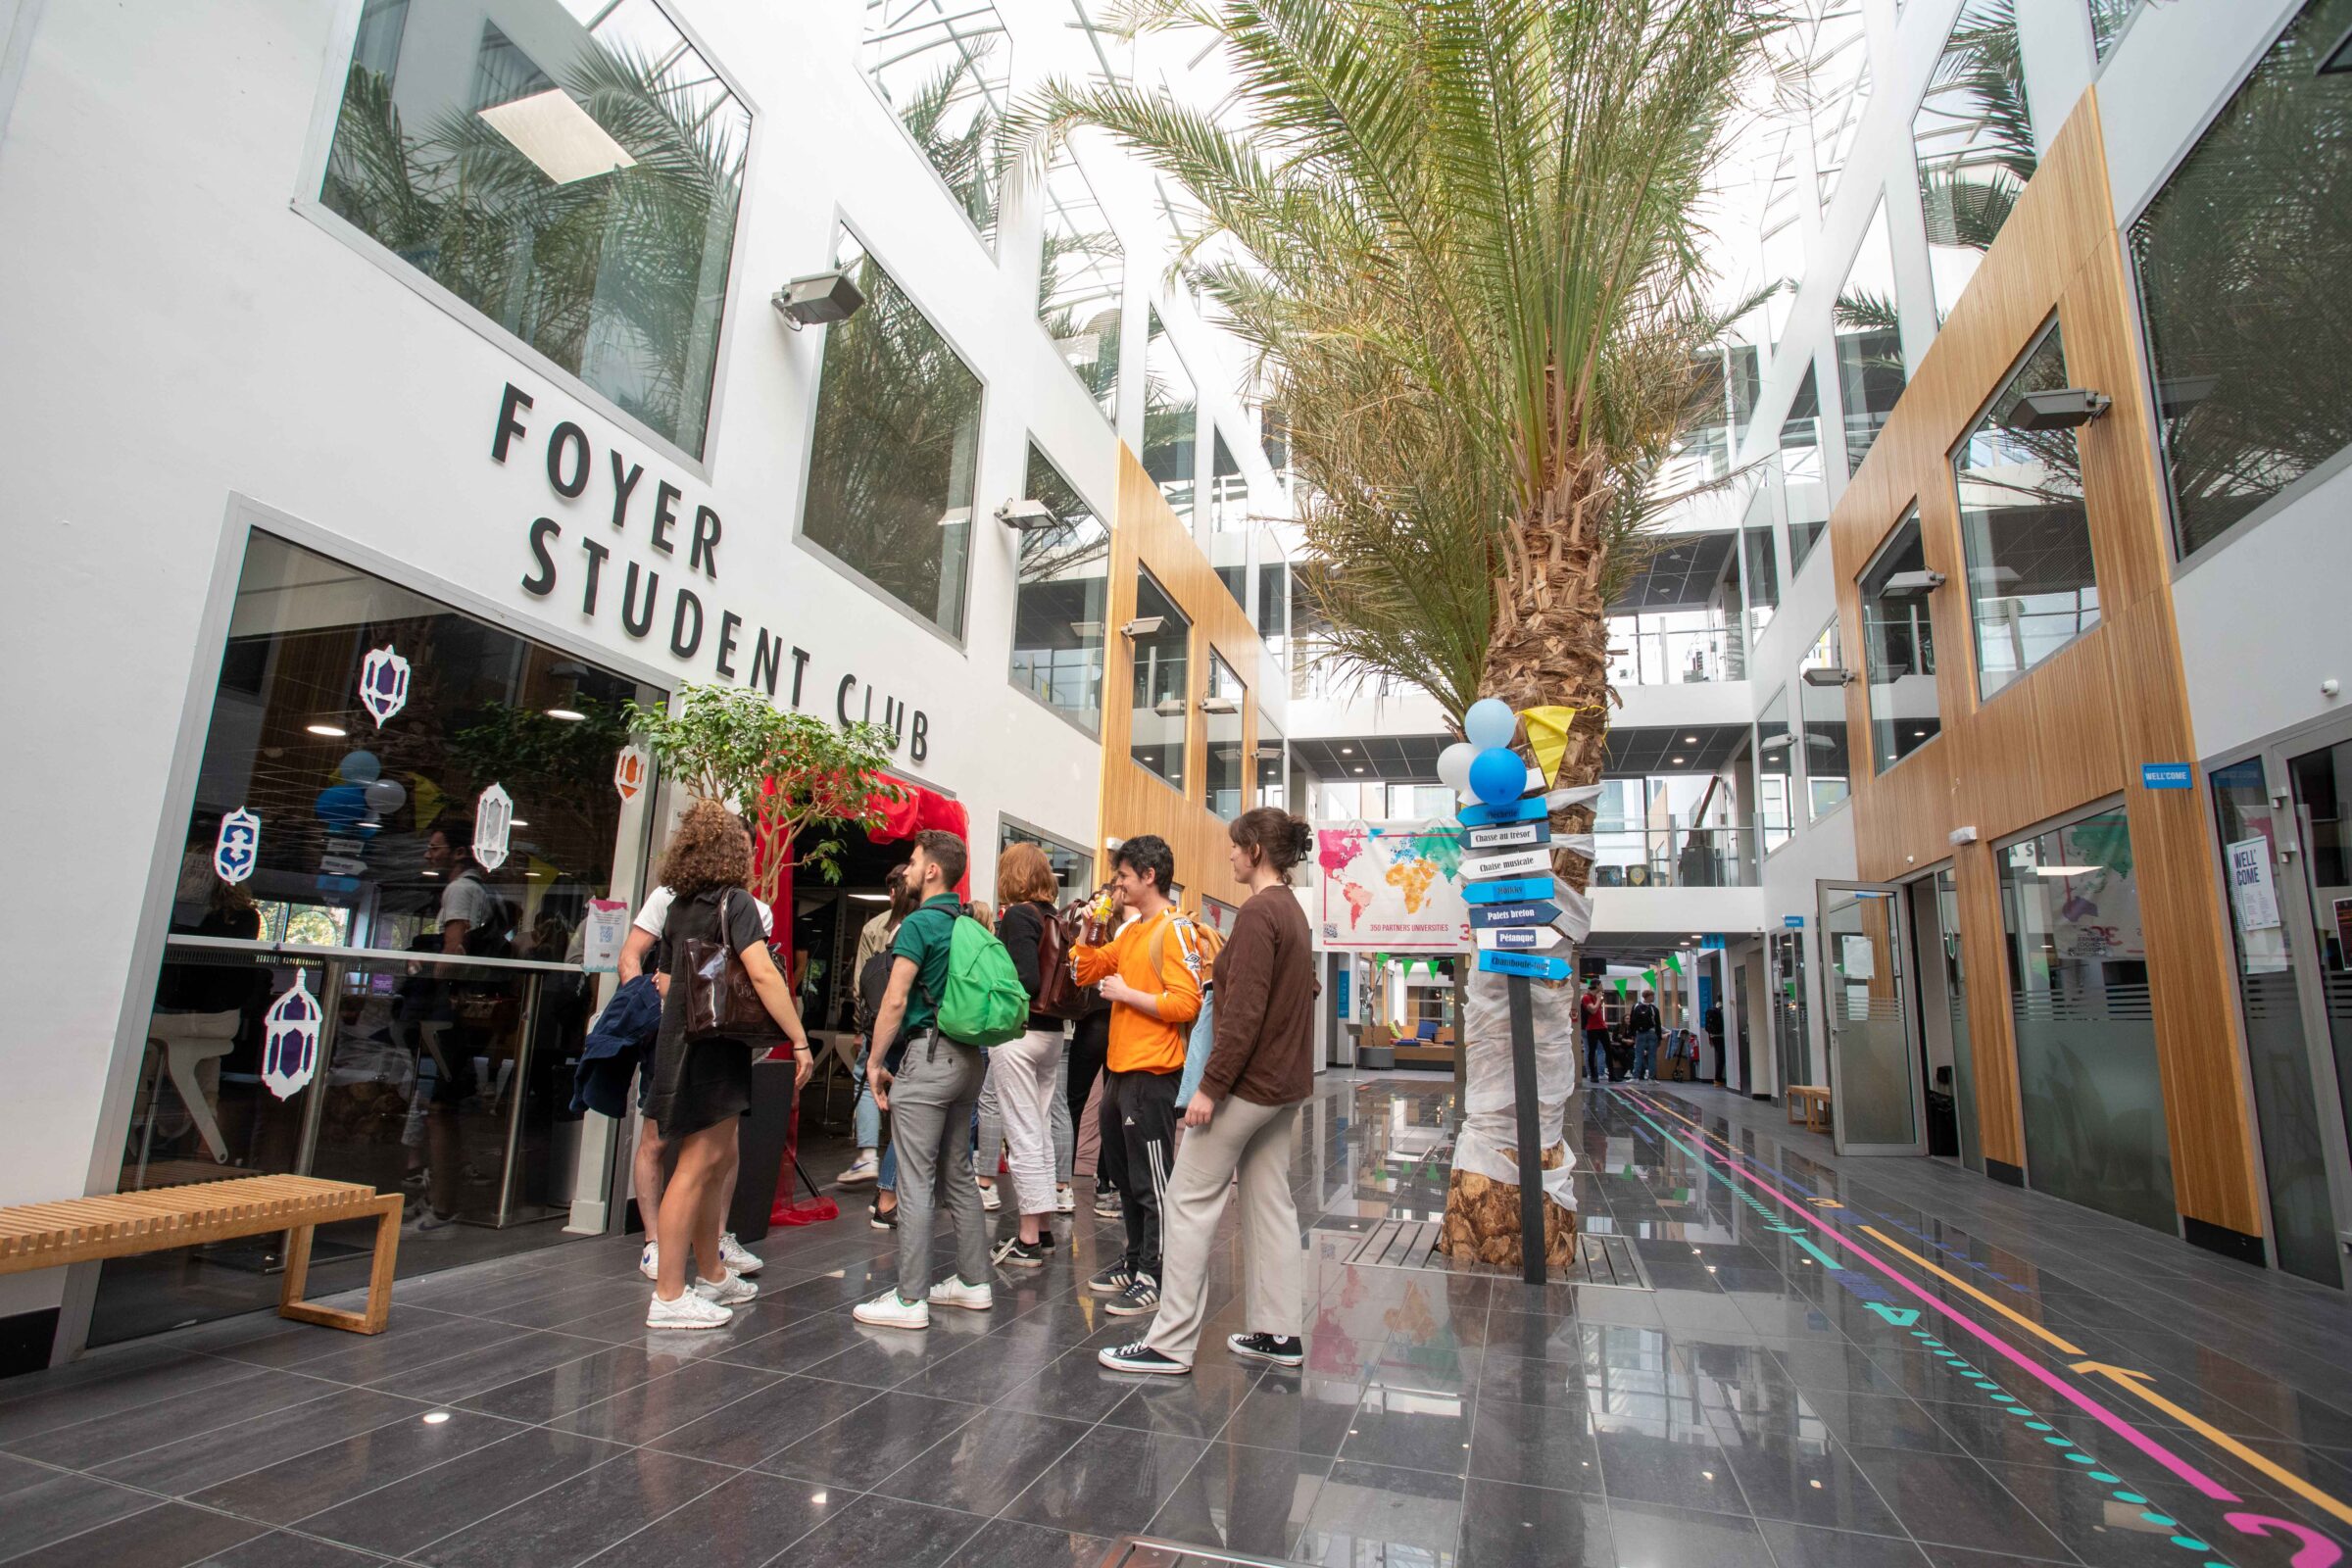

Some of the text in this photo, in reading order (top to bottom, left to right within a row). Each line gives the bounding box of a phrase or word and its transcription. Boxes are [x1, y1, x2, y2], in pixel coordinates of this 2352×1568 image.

[491, 381, 722, 579] FOYER
[521, 516, 929, 762] STUDENT CLUB
[1475, 832, 1498, 843] Chasse
[1510, 830, 1531, 839] trésor
[1479, 857, 1535, 872] Chaise musicale
[2236, 867, 2260, 886] COME
[1487, 908, 1535, 921] Palets breton
[1411, 923, 1448, 932] UNIVERSITIES
[1499, 933, 1535, 944] Pétanque
